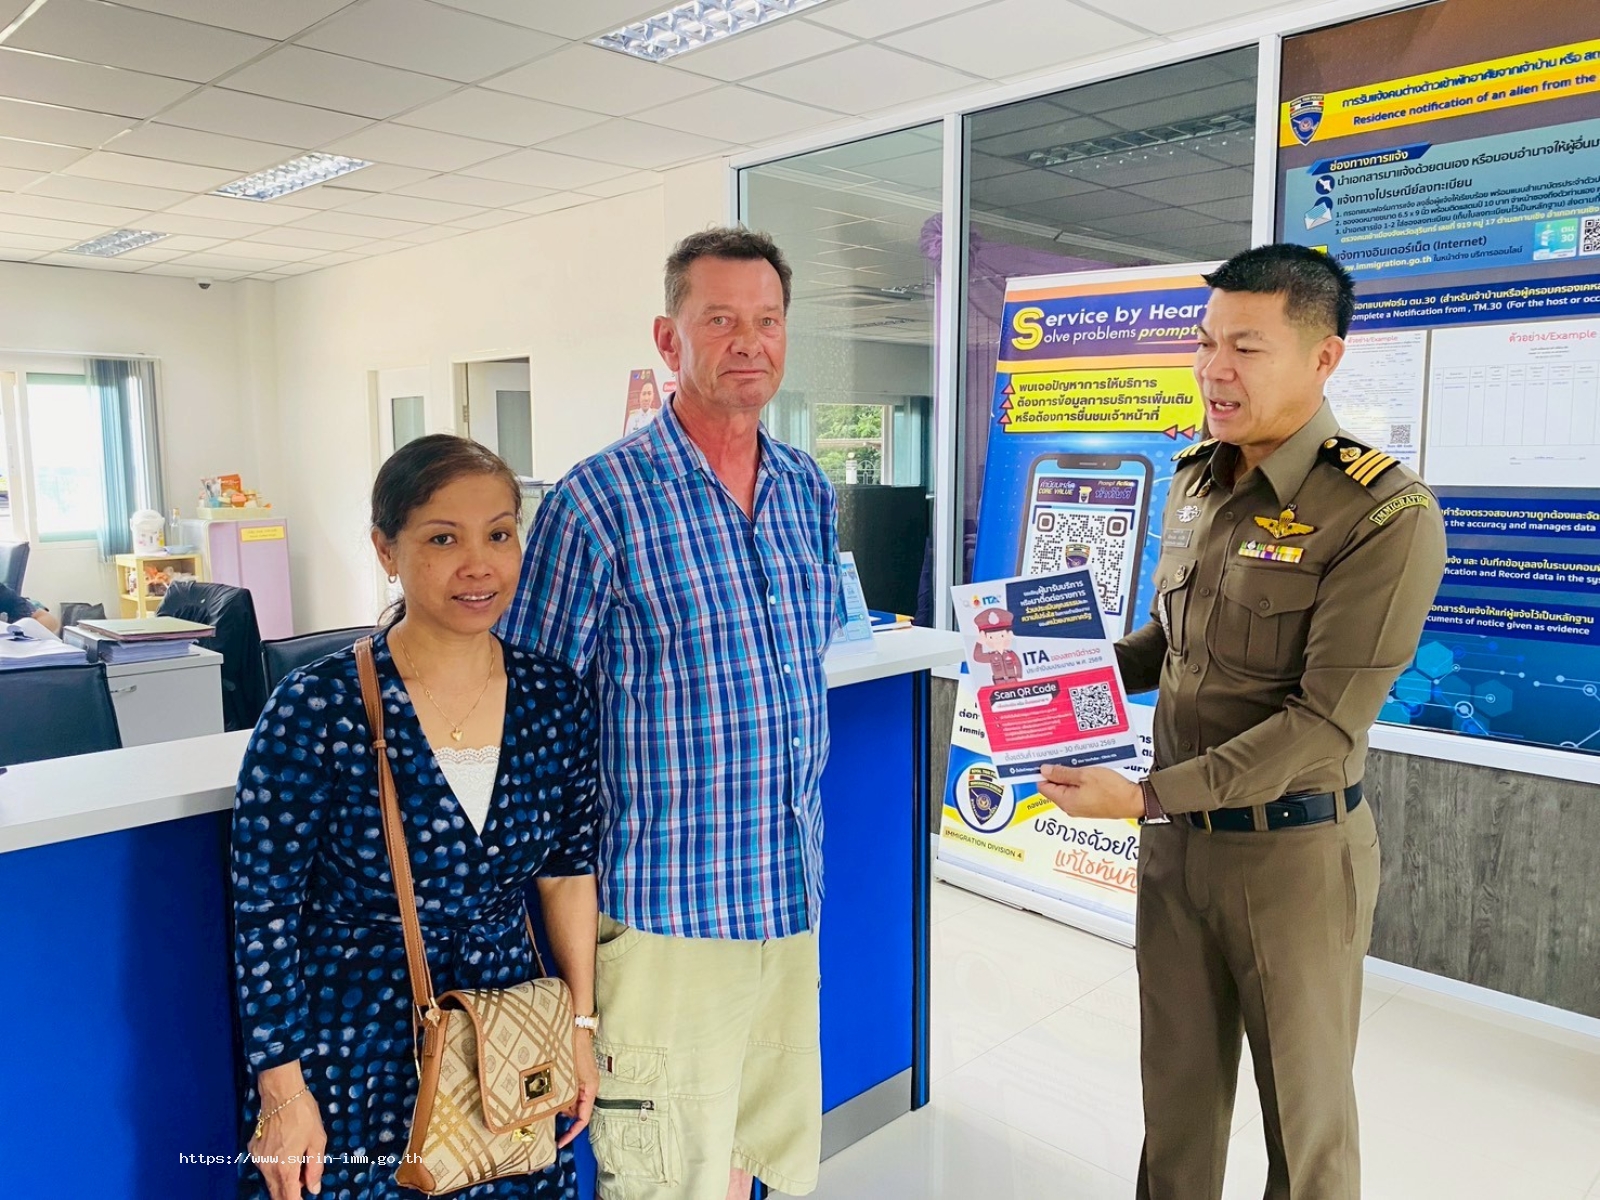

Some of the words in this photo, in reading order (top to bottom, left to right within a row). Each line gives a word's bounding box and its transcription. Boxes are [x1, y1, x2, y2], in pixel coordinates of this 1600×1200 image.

[1560, 52, 1582, 66] หรือ
[1353, 111, 1406, 126] Residence
[1409, 97, 1473, 116] notification
[1477, 92, 1489, 103] of
[1491, 91, 1506, 100] an
[1509, 85, 1538, 97] alien
[1542, 79, 1571, 91] from
[1575, 74, 1597, 85] the
[1329, 150, 1409, 172] ช่องทางการแจ้ง
[1337, 158, 1469, 186] นำเอกสารมาแจ้งด้วยตนเอง
[1337, 178, 1472, 205] แจ้งทางไปรษณีย์ลงทะเบียน
[1433, 235, 1487, 251] (Internet)
[1561, 233, 1575, 242] 30
[1115, 305, 1142, 324] by
[1149, 303, 1208, 321] Hear
[1393, 307, 1443, 318] Notification
[1444, 305, 1467, 314] from
[1473, 301, 1502, 311] TM.30
[1506, 300, 1526, 310] (For
[1528, 298, 1544, 307] the
[1546, 297, 1568, 306] host
[1073, 329, 1136, 345] problems
[1509, 329, 1598, 343] ตัวอย่าง/Example
[1019, 376, 1158, 392] พบเจอปัญหาการให้บริการ
[1017, 390, 1193, 409] ต้องการข้อมูลการบริการเพิ่มเติม
[1015, 406, 1160, 424] หรือต้องการชื่นชมเจ้าหน้าที่
[1450, 519, 1465, 527] the
[1466, 521, 1507, 531] accuracy
[1508, 521, 1527, 530] and
[1528, 523, 1571, 532] manages
[1573, 523, 1597, 532] data
[1479, 569, 1497, 577] and
[1498, 570, 1531, 580] Record
[1532, 572, 1554, 581] data
[1556, 573, 1566, 582] in
[1567, 574, 1585, 583] the
[1465, 617, 1475, 625] of
[1476, 619, 1505, 628] notice
[1506, 620, 1533, 630] given
[1534, 623, 1545, 631] as
[1546, 624, 1590, 635] evidence
[1022, 650, 1050, 666] ITA
[994, 690, 1016, 700] Scan
[1017, 687, 1031, 698] QR
[1032, 683, 1057, 695] Code
[945, 829, 987, 848] IMMIGRATION
[987, 840, 1016, 858] DIVISION
